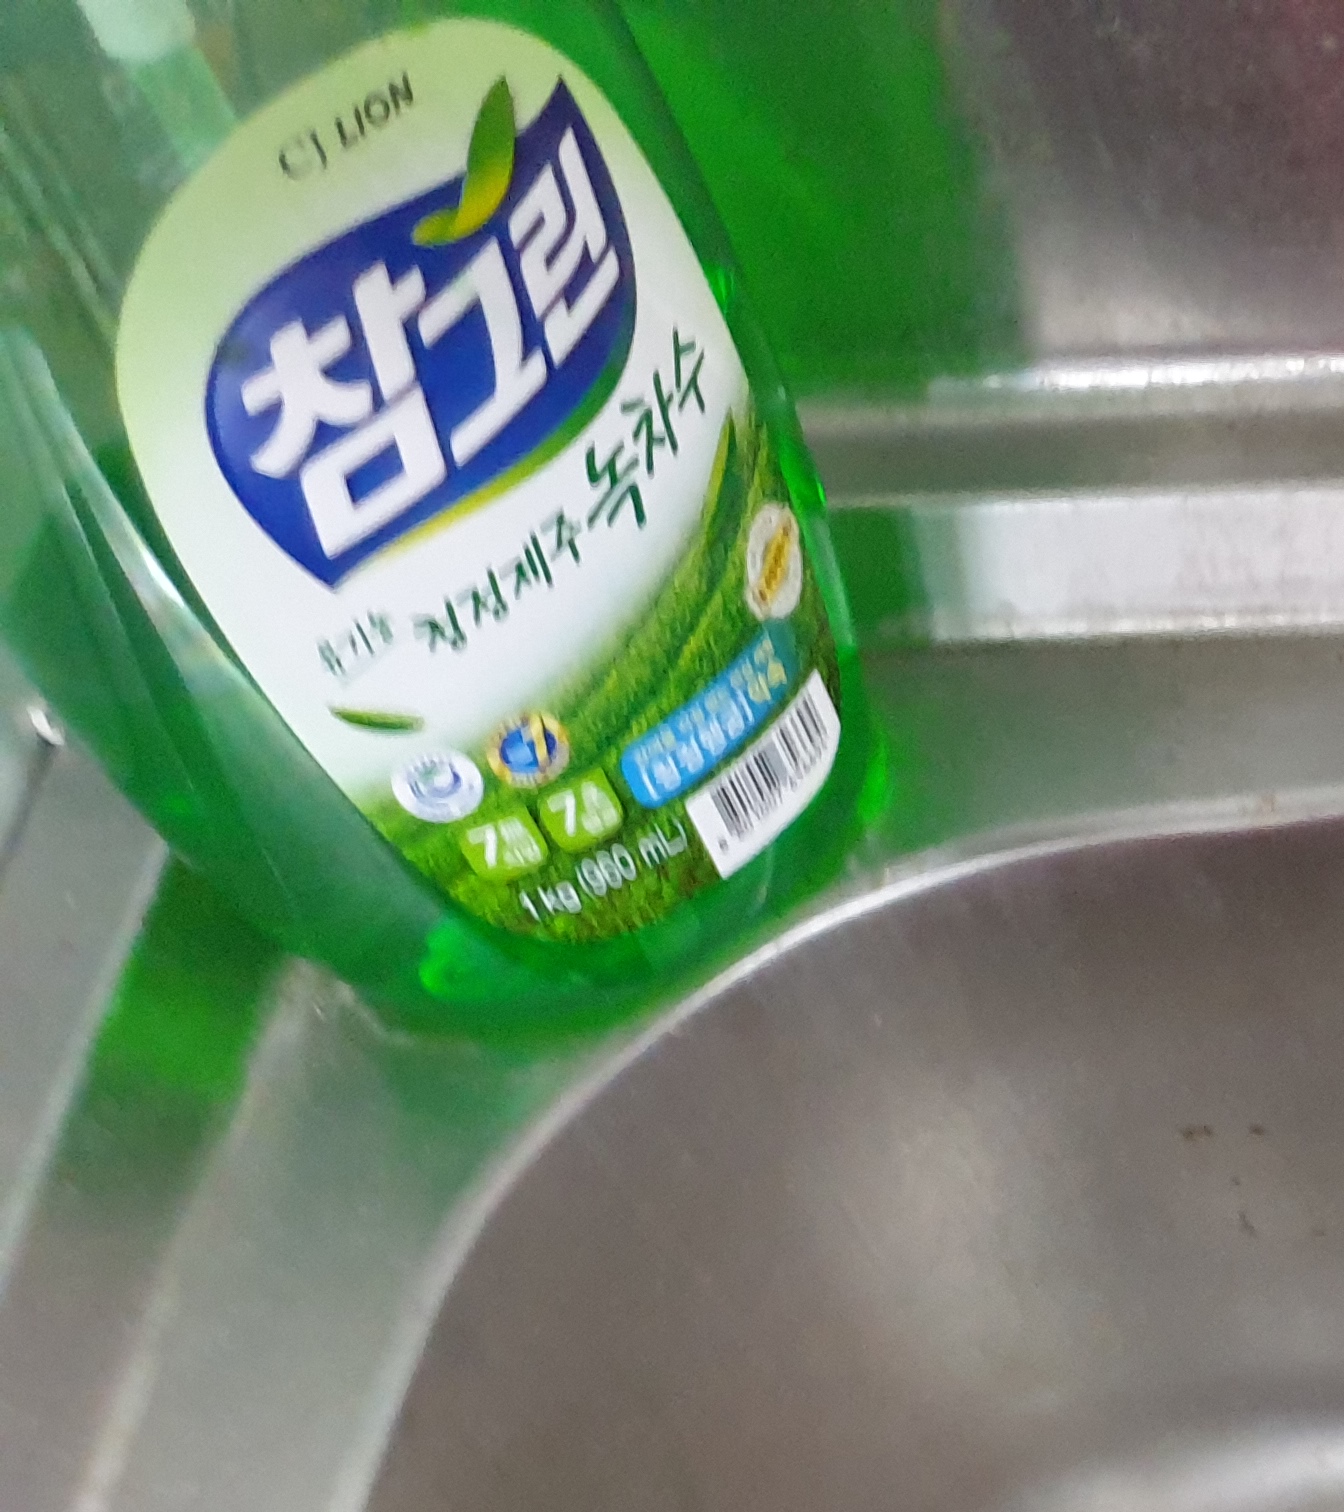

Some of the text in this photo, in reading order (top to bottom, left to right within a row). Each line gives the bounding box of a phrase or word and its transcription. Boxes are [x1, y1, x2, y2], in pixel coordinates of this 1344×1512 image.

[278, 70, 414, 181] CJ LION
[241, 125, 621, 560] 참그린
[585, 323, 706, 530] 녹차수
